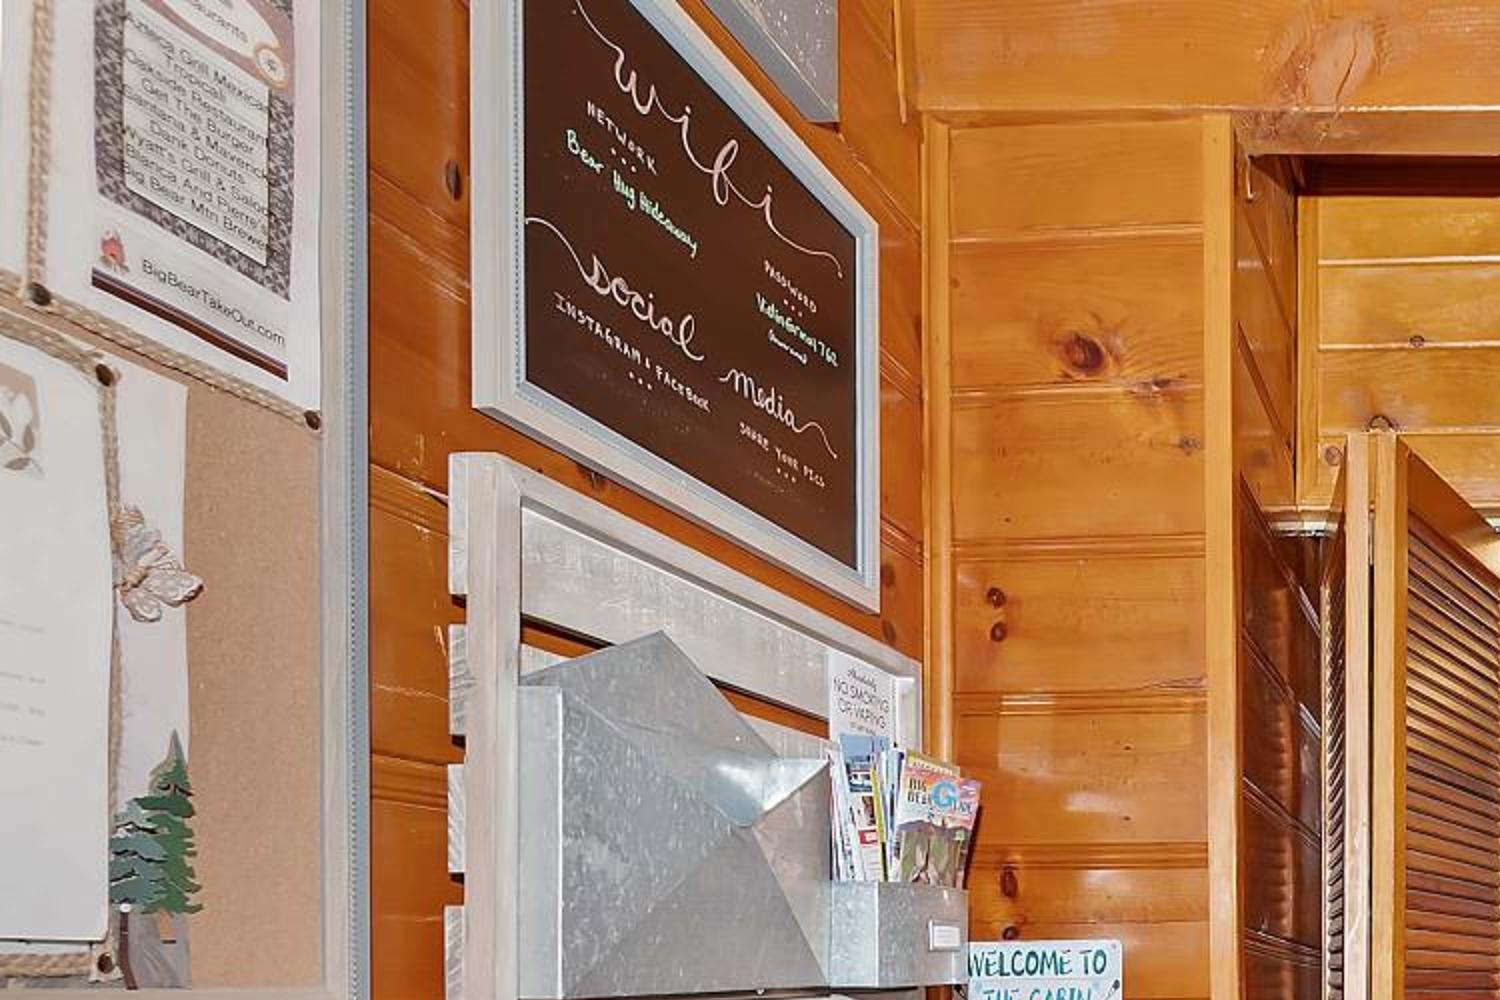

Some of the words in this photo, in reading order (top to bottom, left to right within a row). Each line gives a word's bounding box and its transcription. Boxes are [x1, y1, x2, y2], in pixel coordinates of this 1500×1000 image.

[586, 100, 657, 176] NETWORK
[142, 258, 286, 347] BigBearTakeOut.com
[553, 291, 642, 366] INSTAGRAM
[968, 949, 1073, 978] WELCOME
[1080, 949, 1108, 975] TO
